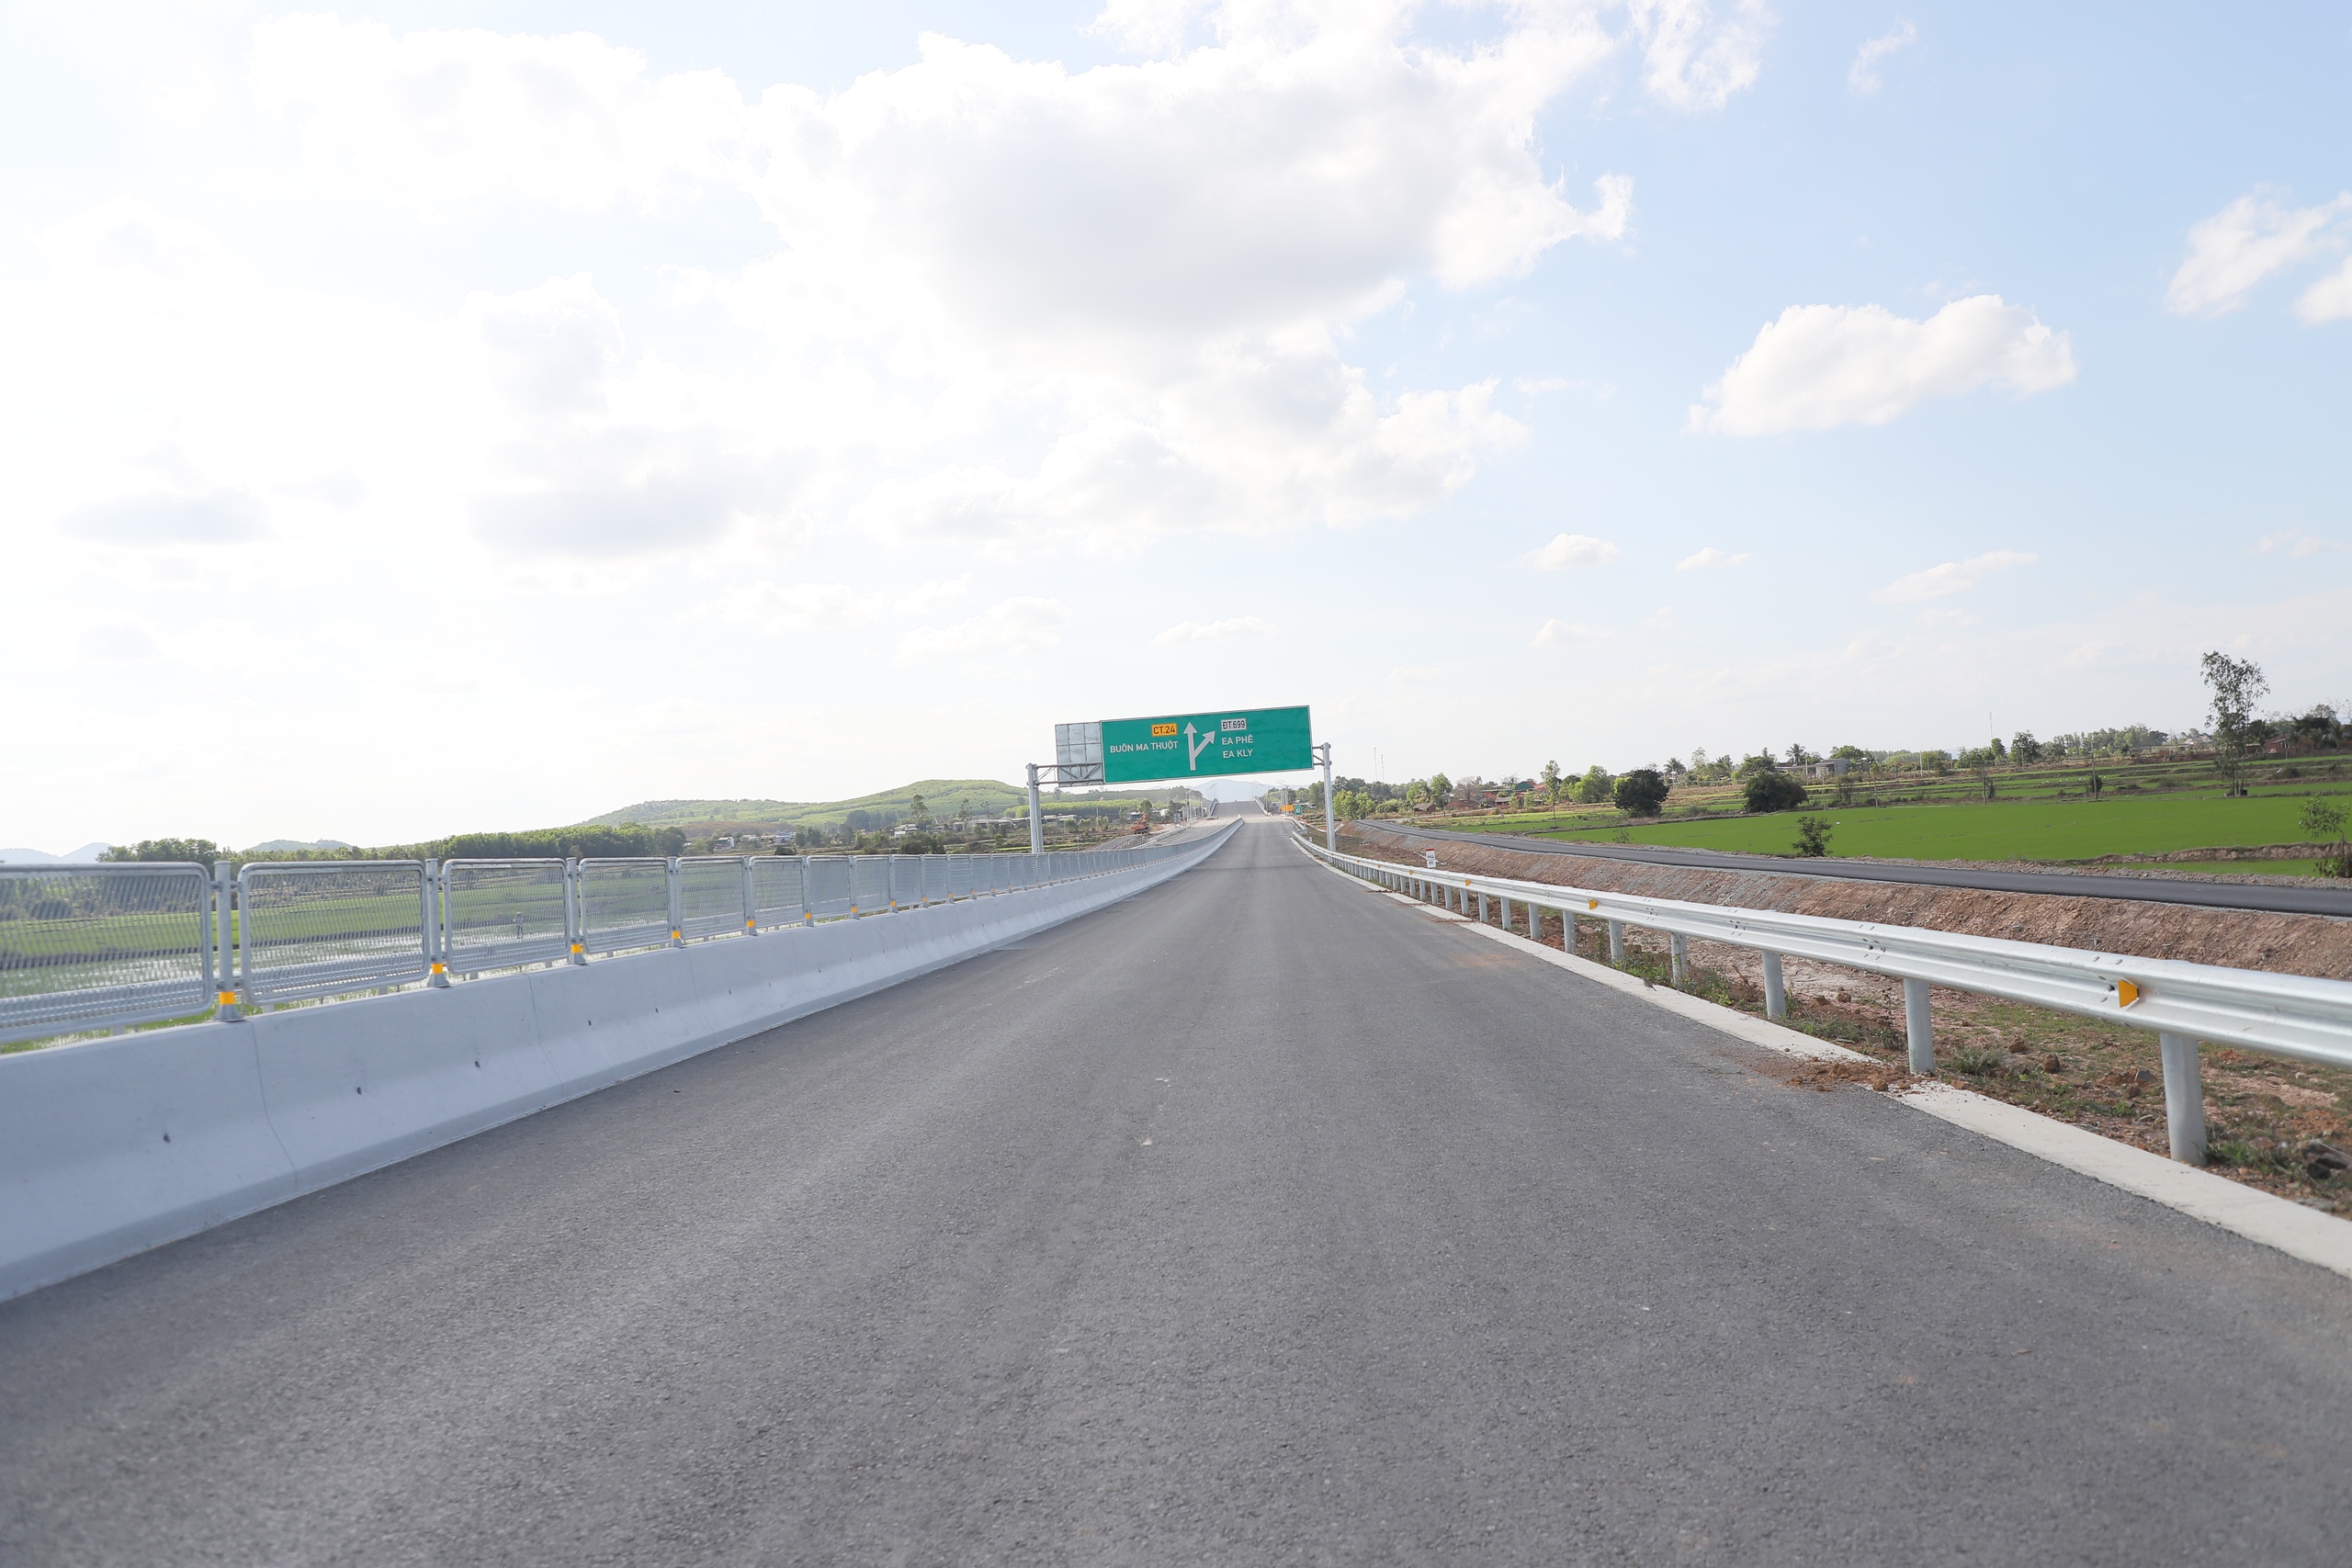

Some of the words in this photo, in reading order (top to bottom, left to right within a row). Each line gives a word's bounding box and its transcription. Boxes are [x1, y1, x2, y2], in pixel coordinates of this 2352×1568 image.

[1222, 720, 1246, 730] ĐT.699
[1153, 726, 1175, 735] CT.24
[1236, 734, 1253, 744] PHÊ
[1110, 743, 1134, 753] BUÔN
[1136, 743, 1149, 751] MA
[1150, 740, 1179, 750] THUỘT
[1223, 750, 1235, 759] EA
[1237, 749, 1253, 758] KLY
